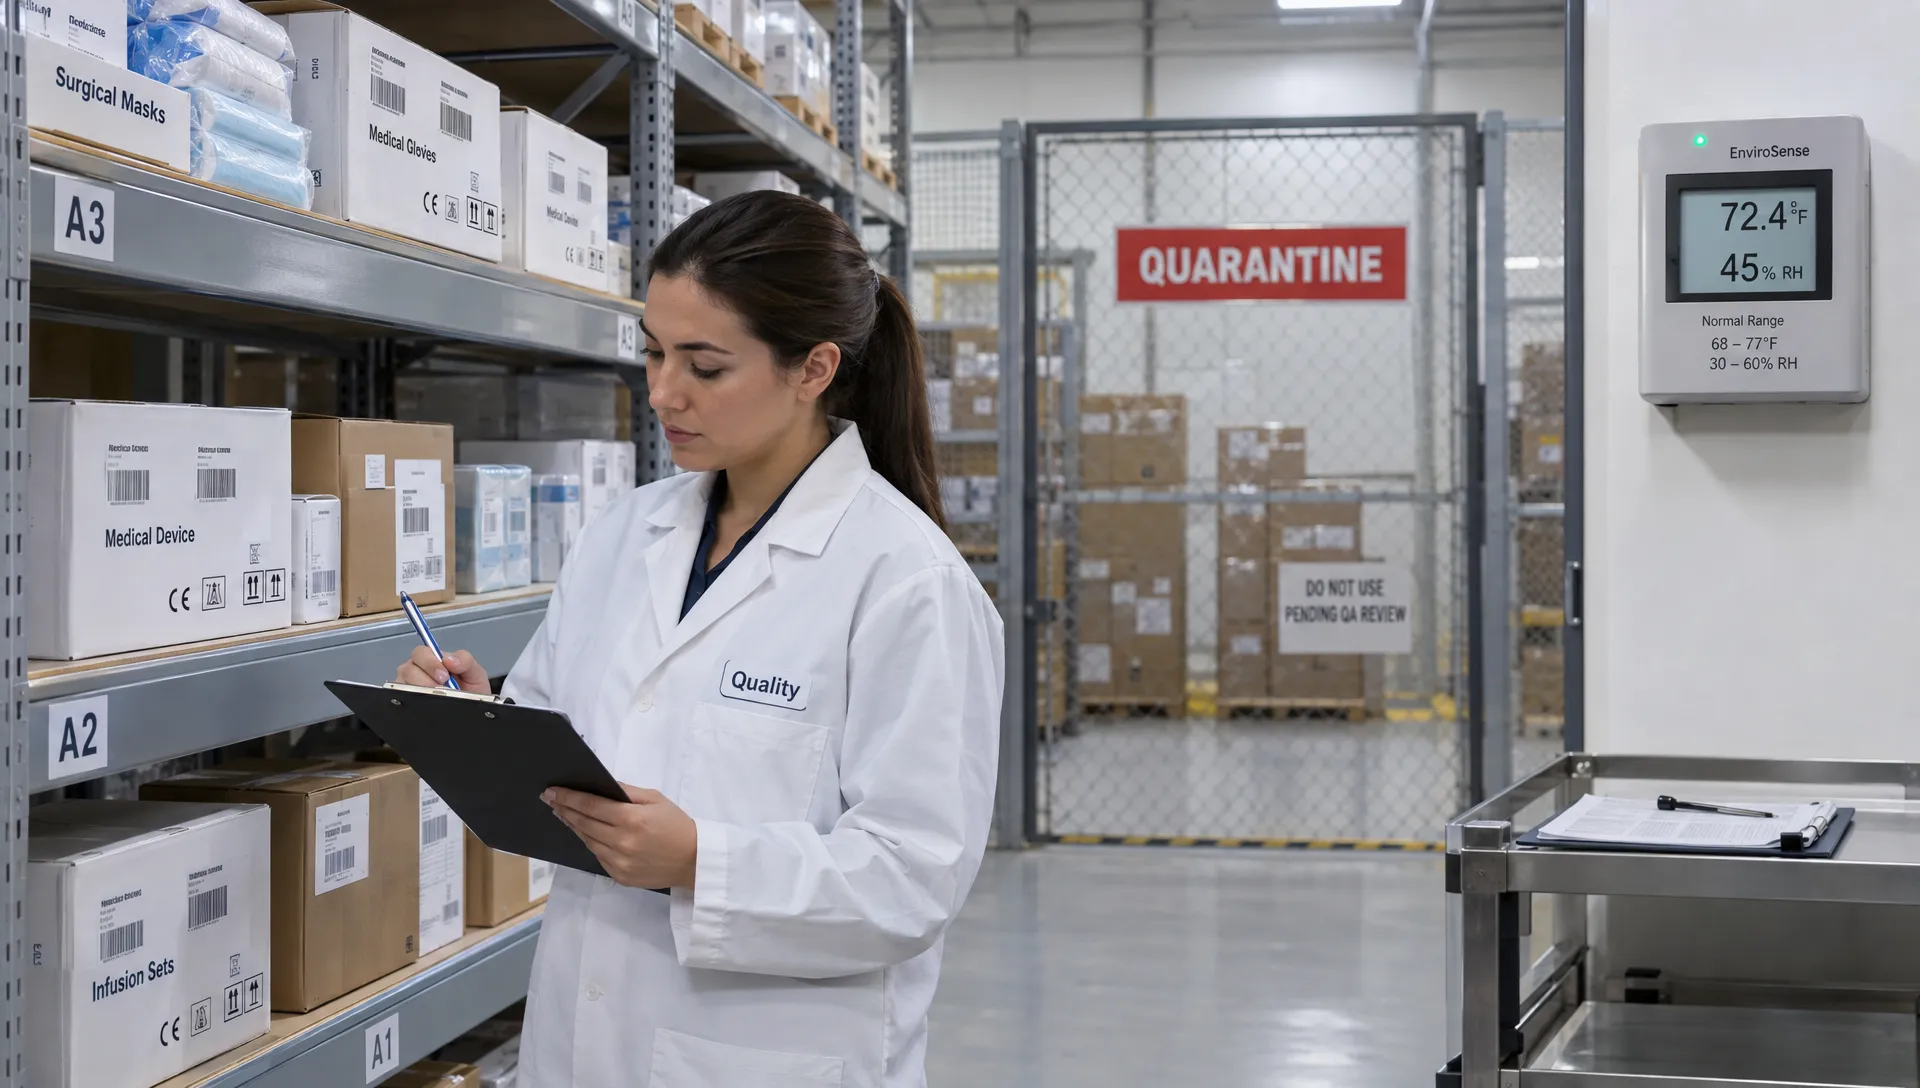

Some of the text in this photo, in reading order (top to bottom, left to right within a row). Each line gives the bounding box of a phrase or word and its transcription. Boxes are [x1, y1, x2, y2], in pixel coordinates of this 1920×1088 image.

[56, 65, 166, 124] Surgical Masks
[369, 123, 437, 163] Medical Gloves
[1730, 145, 1810, 159] EnviroSense
[423, 191, 438, 216] CE
[65, 195, 105, 245] A3
[1138, 246, 1383, 287] QUARANTINE
[1782, 266, 1803, 279] RH
[1702, 315, 1784, 328] Normal Range
[1711, 337, 1728, 350] 68
[1746, 337, 1778, 350] 77°F
[1710, 357, 1727, 370] 30
[1743, 357, 1774, 370] 60%
[1778, 357, 1798, 369] RH
[105, 525, 195, 548] Medical Device
[169, 587, 190, 613] CE
[1306, 579, 1385, 597] DO NOT USE
[1285, 605, 1407, 623] PENDING QA REVIEW
[731, 670, 801, 702] Quality
[58, 712, 98, 763] A2
[92, 957, 174, 1002] Infusion Sets
[160, 1016, 180, 1047] CE
[372, 1027, 391, 1070] A1
